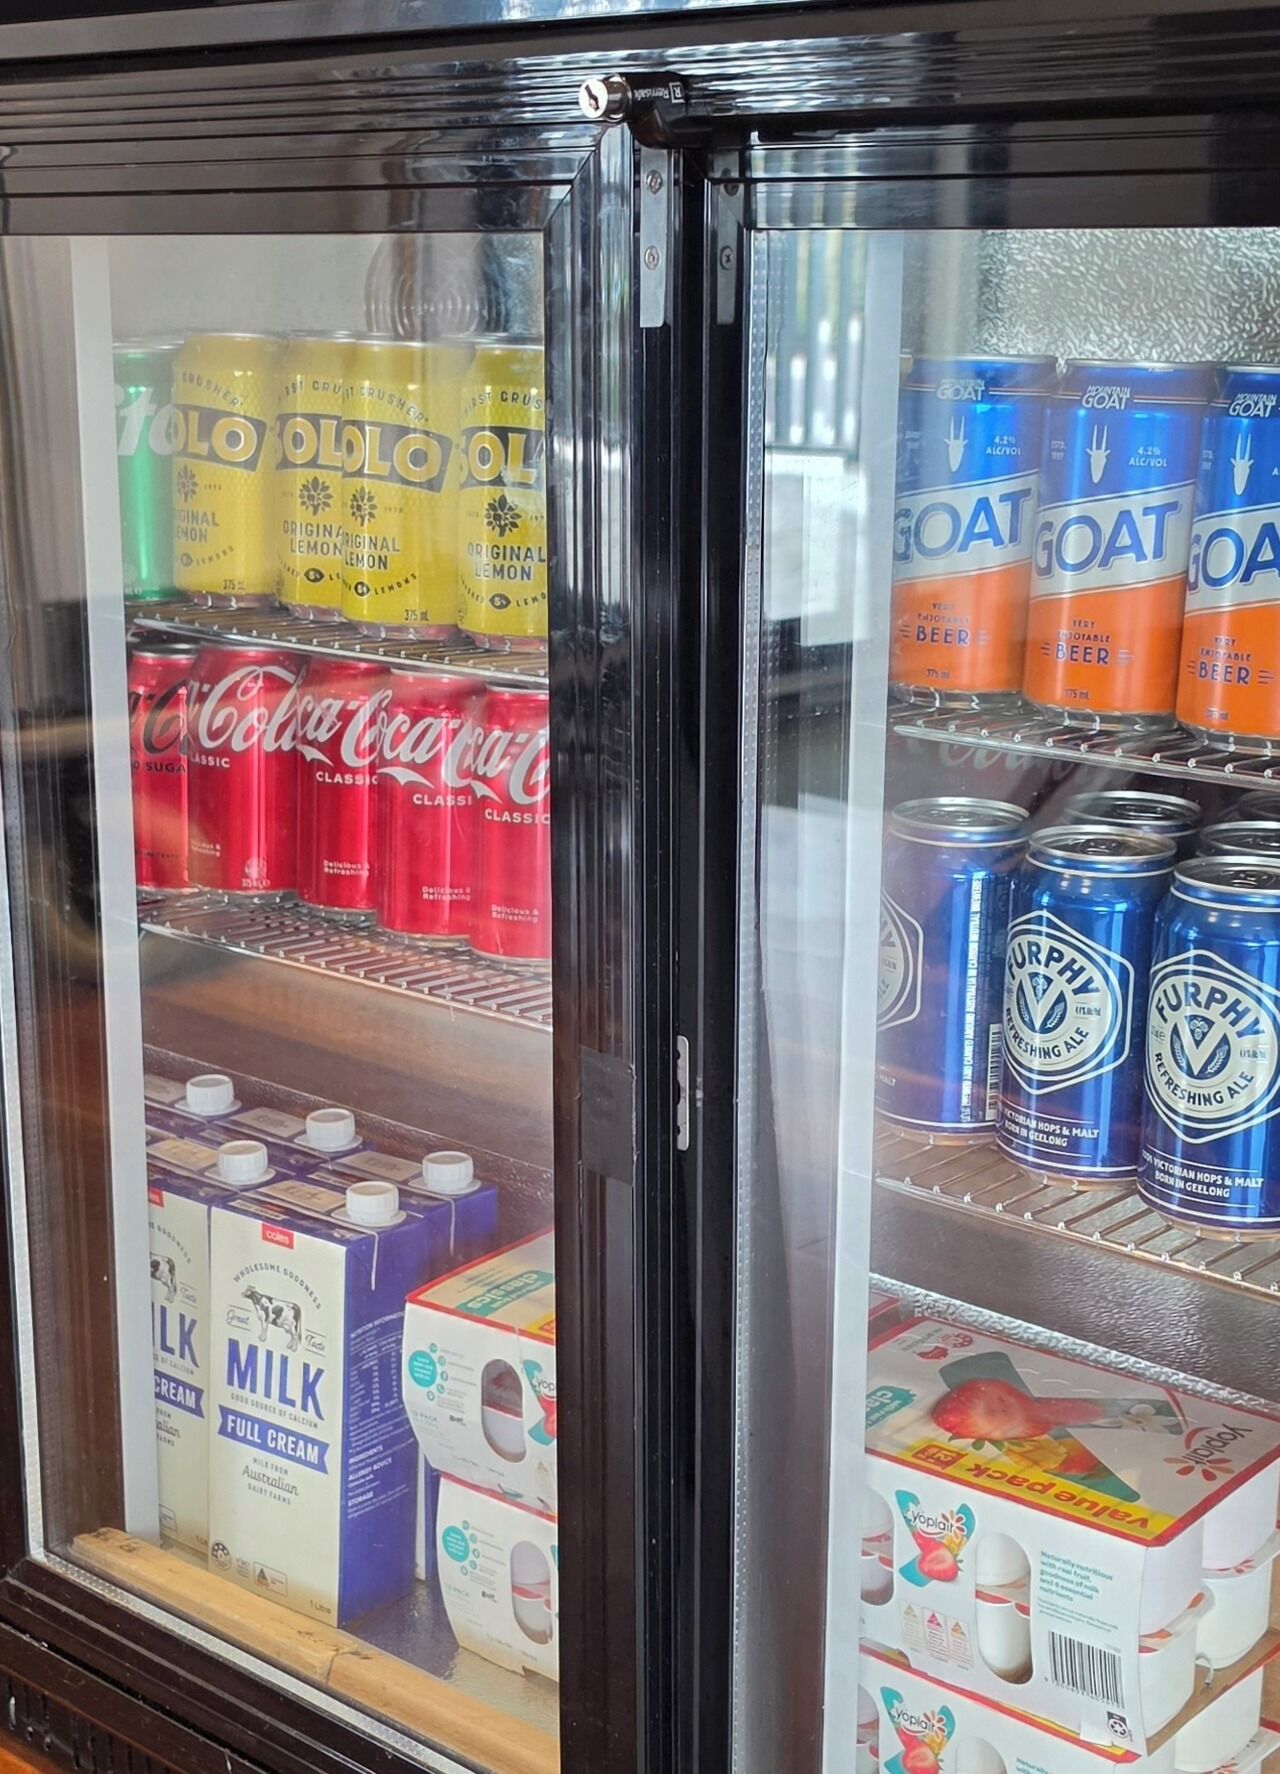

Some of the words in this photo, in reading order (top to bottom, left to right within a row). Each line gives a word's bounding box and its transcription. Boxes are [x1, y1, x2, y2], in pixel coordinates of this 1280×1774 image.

[500, 390, 543, 410] CRUS
[1086, 385, 1131, 397] MOUNTAIN
[1235, 393, 1278, 405] MOUNTAIN
[1082, 394, 1129, 410] GOAT
[1228, 402, 1276, 418] GOAT
[1128, 457, 1168, 467] ALC/VOL
[893, 487, 1033, 564] GOAT
[290, 539, 343, 558] LEMON
[1034, 500, 1182, 577] GOAT
[344, 553, 389, 571] LEMON
[467, 542, 546, 563] ORIGINAL
[475, 563, 532, 582] LEMON
[516, 591, 546, 608] LEMO
[404, 608, 418, 621] 375
[915, 625, 971, 645] BEER
[1055, 643, 1111, 665] BEER
[1198, 660, 1251, 685] BEER
[145, 760, 187, 774] SUGA
[189, 753, 231, 769] LASSIC
[412, 793, 472, 807] CLASSI
[484, 808, 551, 825] CLASSIC
[1007, 940, 1100, 996] FURPHY
[1155, 981, 1266, 1040] FURPHY
[1006, 1007, 1062, 1060] REFRESHING
[1064, 1026, 1090, 1054] ALE
[1154, 1052, 1224, 1107] REFRESHING
[1227, 1071, 1255, 1100] ALE
[1038, 1120, 1061, 1134] HOPS
[1072, 1127, 1100, 1139] MALT
[1153, 1154, 1195, 1180] VICTORIAN
[1196, 1170, 1222, 1185] HOPS
[1234, 1176, 1264, 1188] MALT
[233, 1262, 281, 1282] WHOLESOME
[226, 1337, 325, 1421] MILK
[154, 1375, 196, 1410] CREAM
[227, 1414, 262, 1443] FULL
[267, 1428, 319, 1465] CREAM
[242, 1464, 299, 1496] Australian
[965, 1462, 1056, 1498] pack
[1056, 1490, 1150, 1531] value
[911, 1508, 956, 1535] yoplait
[1040, 1551, 1075, 1569] Naturally
[1075, 1563, 1114, 1581] nutritious
[1040, 1560, 1057, 1571] with
[1058, 1566, 1073, 1576] real
[1040, 1569, 1076, 1586] goodness
[1084, 1581, 1100, 1594] milk
[1040, 1577, 1054, 1587] and
[1060, 1583, 1094, 1600] essential
[895, 1706, 937, 1733] yoplait
